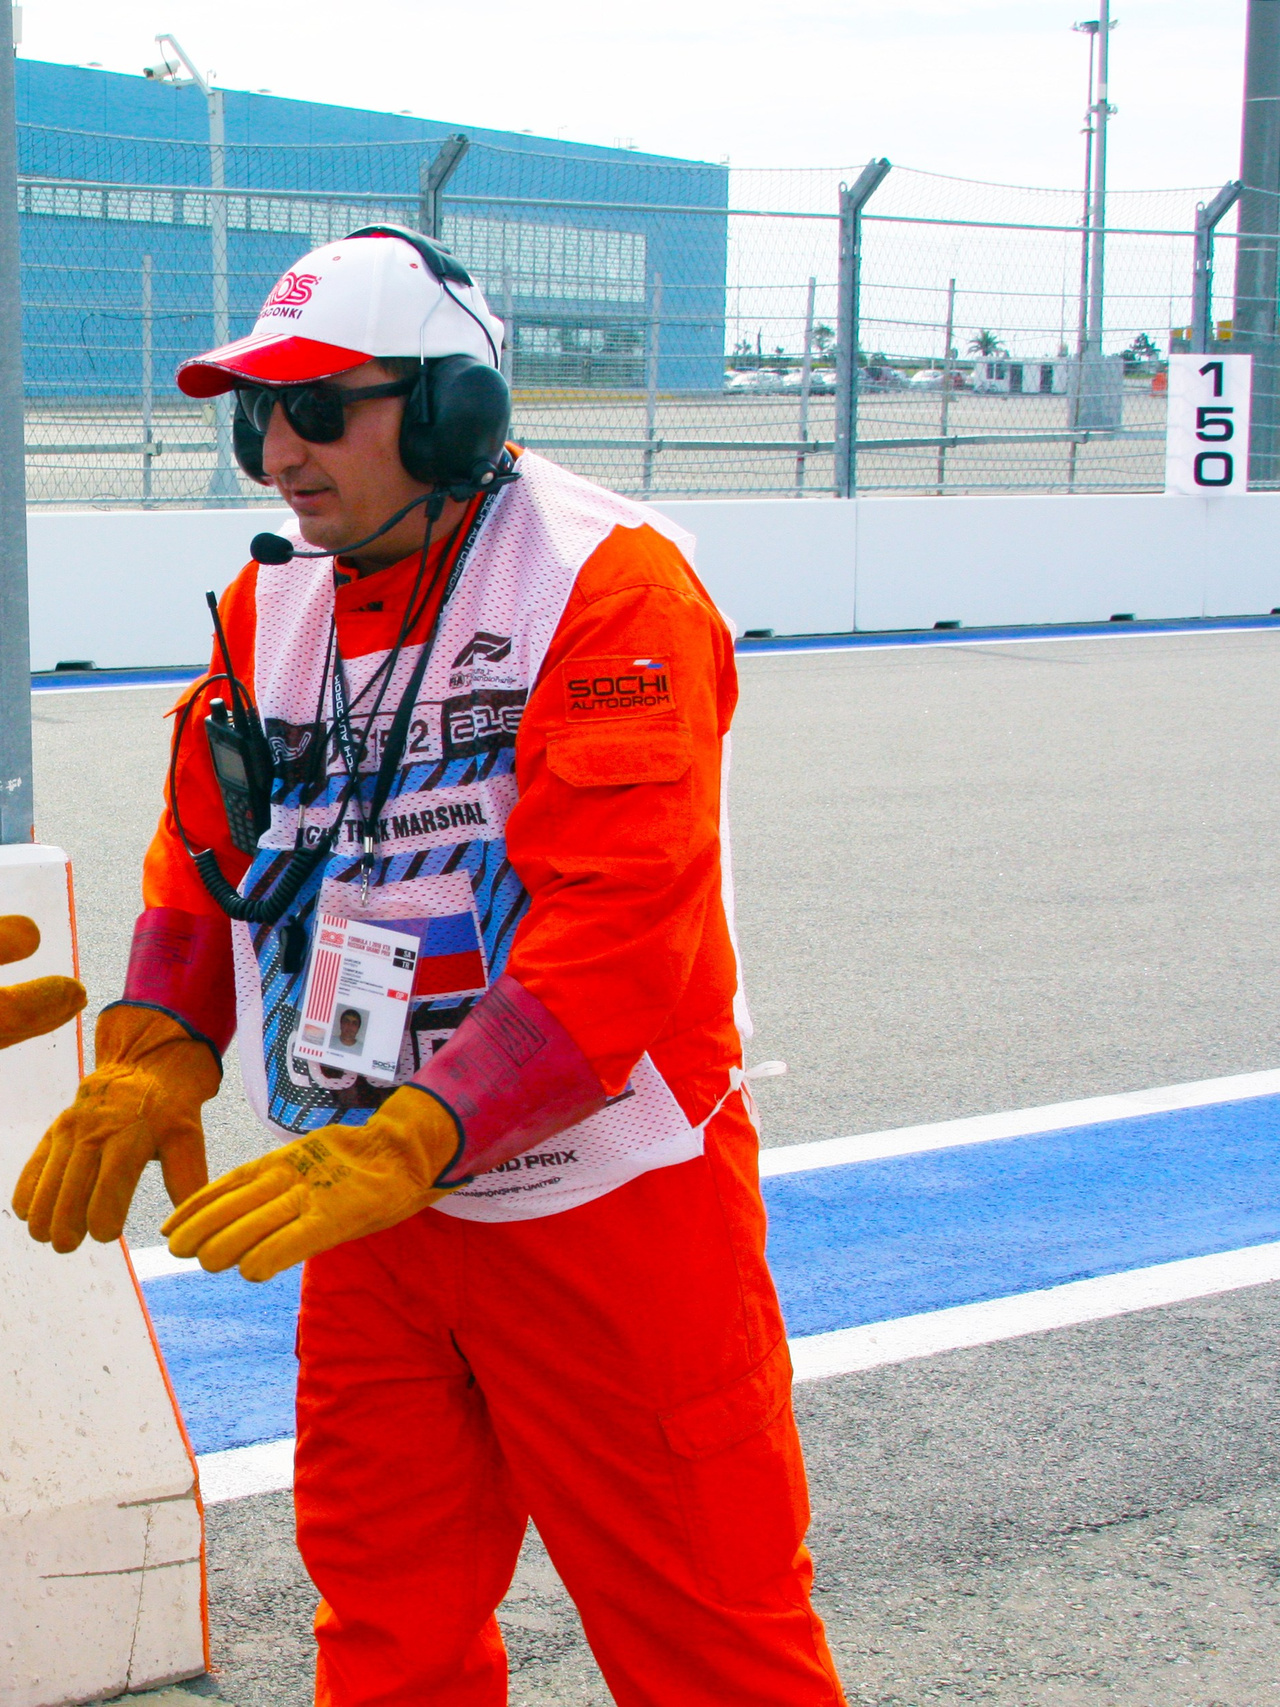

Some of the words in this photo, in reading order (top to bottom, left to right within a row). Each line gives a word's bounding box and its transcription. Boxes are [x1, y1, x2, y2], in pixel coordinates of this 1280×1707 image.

[1194, 362, 1234, 486] 150
[568, 675, 668, 698] SOCHI
[570, 695, 670, 711] AUTODROM
[391, 802, 488, 839] MARSHAL
[523, 1149, 578, 1169] PRIX
